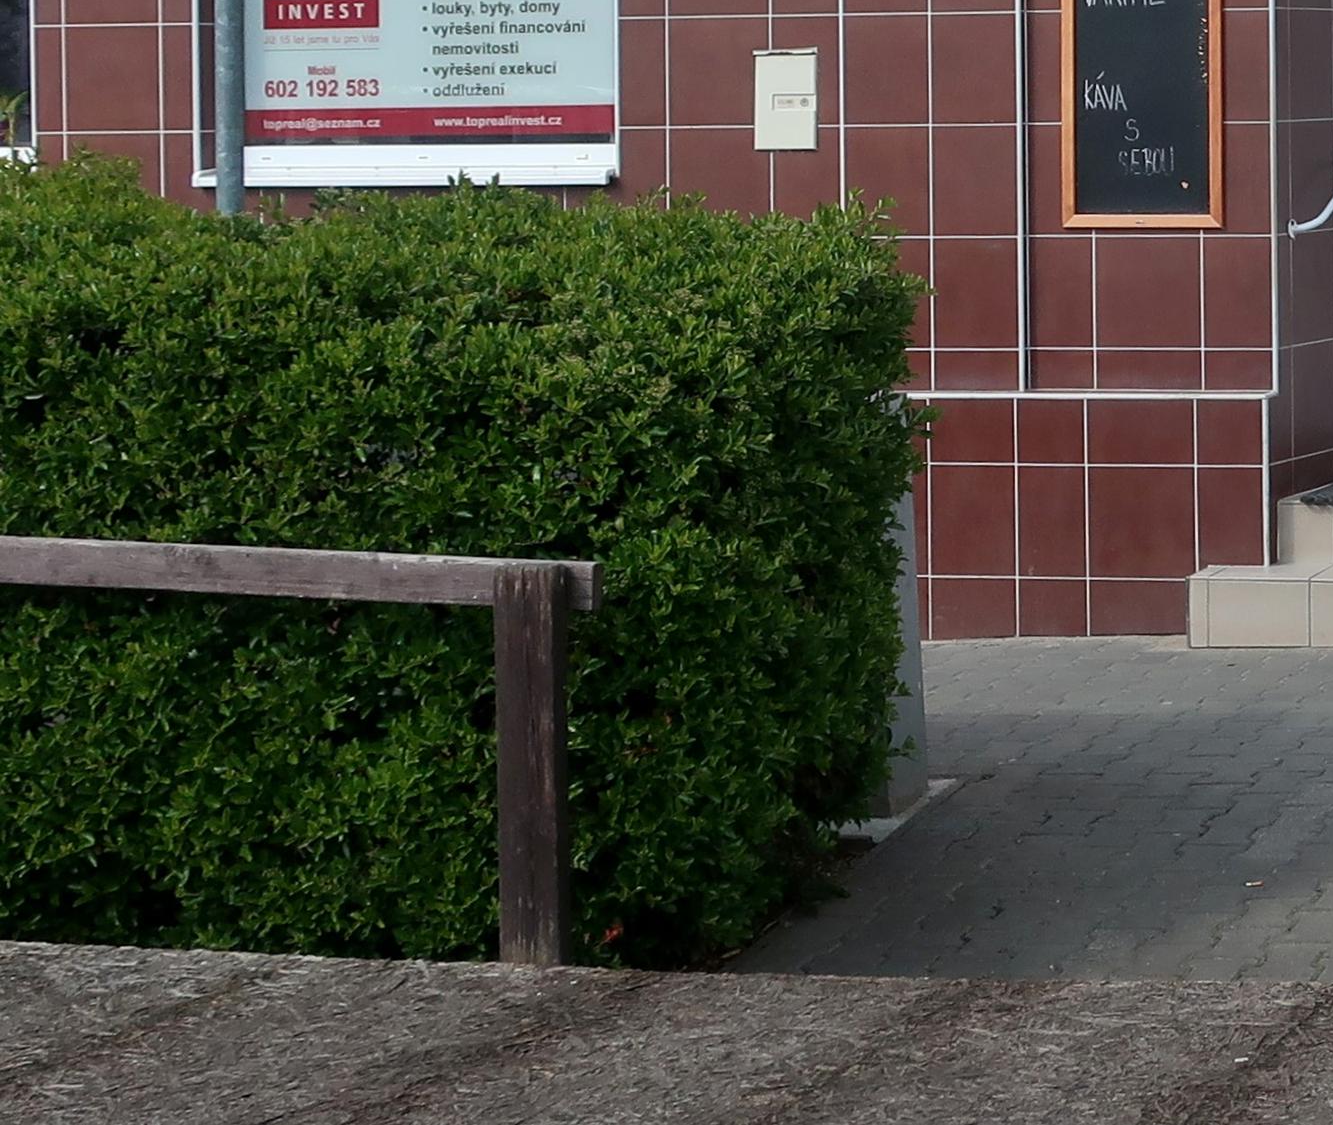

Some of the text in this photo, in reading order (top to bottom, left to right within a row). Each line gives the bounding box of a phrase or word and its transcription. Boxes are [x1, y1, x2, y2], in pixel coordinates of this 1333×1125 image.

[277, 2, 366, 21] INVEST
[431, 0, 561, 17] louky, byty, domy
[431, 19, 586, 38] vyřešení financování
[307, 65, 336, 75] Mobil
[432, 61, 496, 79] vyřešení
[264, 78, 380, 98] 602 192 583
[432, 83, 505, 97] oddlužení
[1084, 70, 1128, 111] KÁVA
[263, 118, 381, 132] topreal@seznam.cz
[433, 115, 563, 129] www.toprealinvest.cz
[1124, 118, 1140, 142] S
